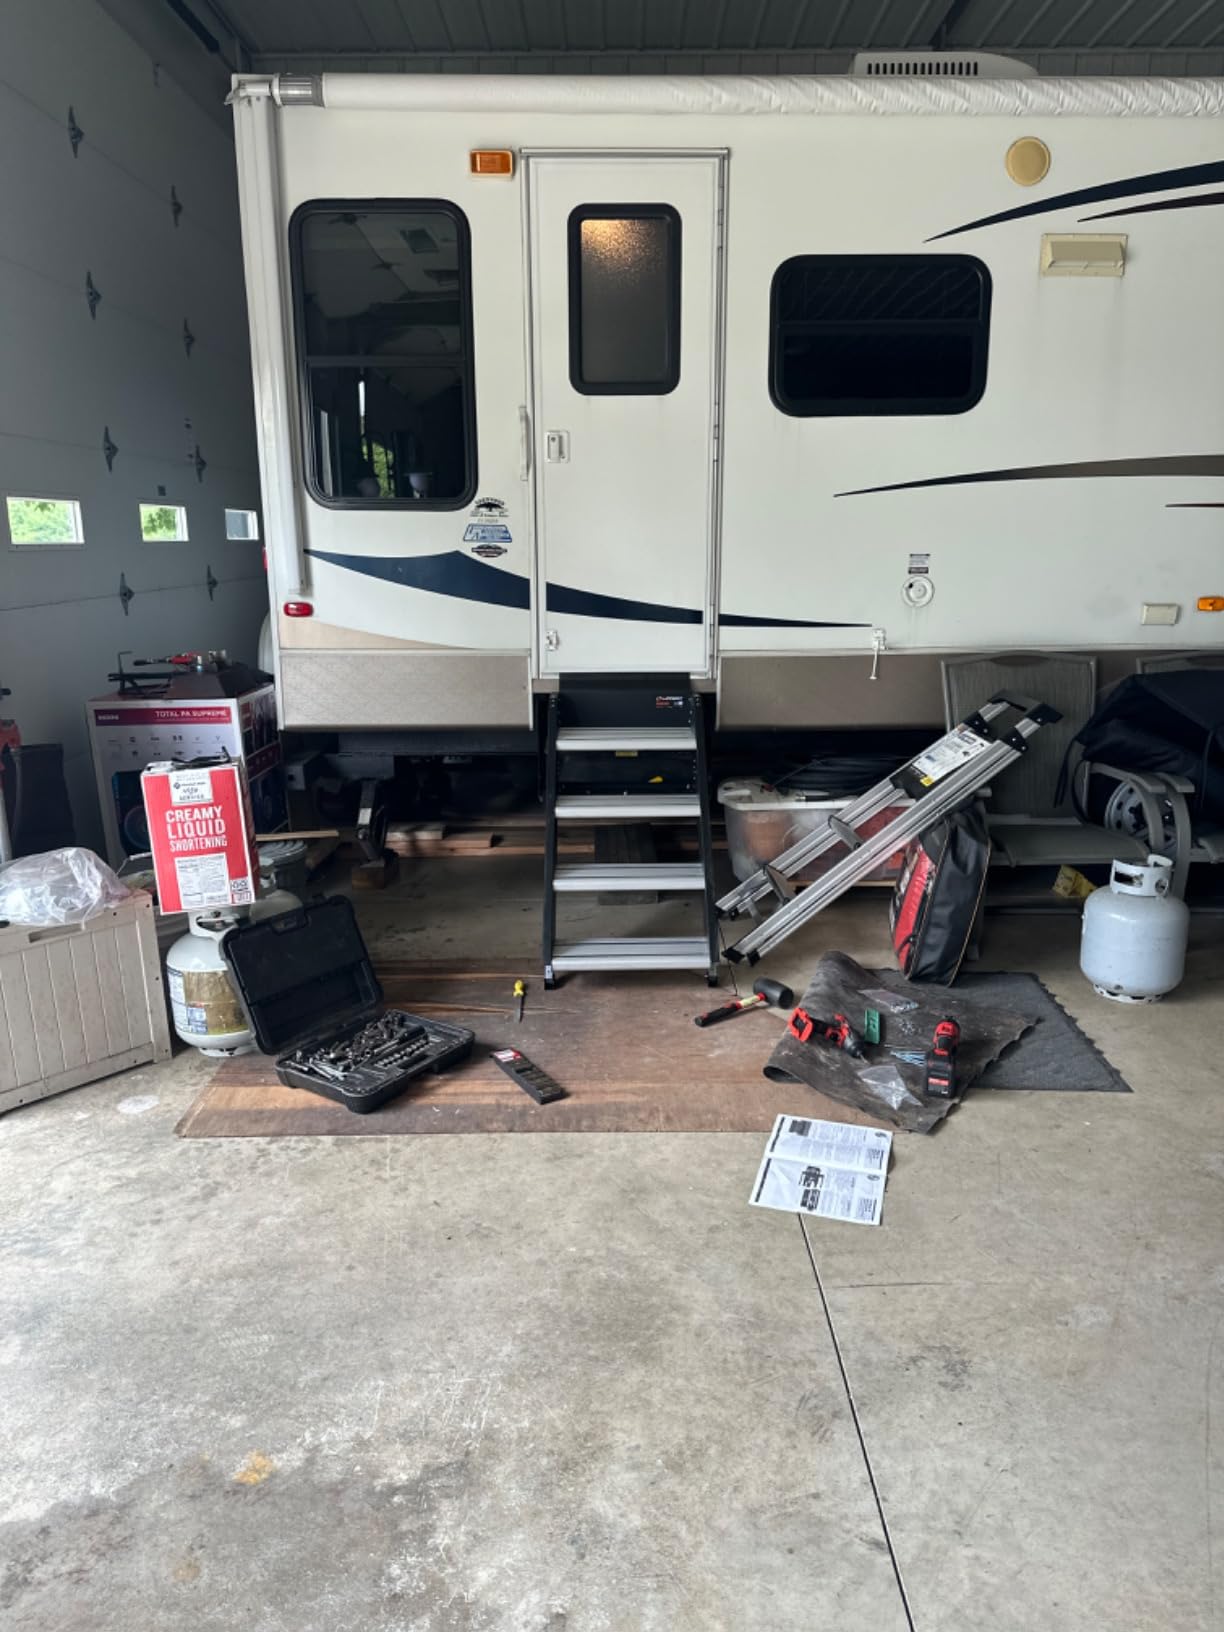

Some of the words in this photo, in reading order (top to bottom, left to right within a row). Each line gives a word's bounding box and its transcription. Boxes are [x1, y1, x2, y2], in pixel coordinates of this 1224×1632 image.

[155, 710, 179, 718] TOTAL
[192, 709, 227, 717] SUPREME
[165, 805, 223, 823] CREAMY
[166, 819, 226, 839] LIQUID
[169, 835, 228, 852] SHORTENING
